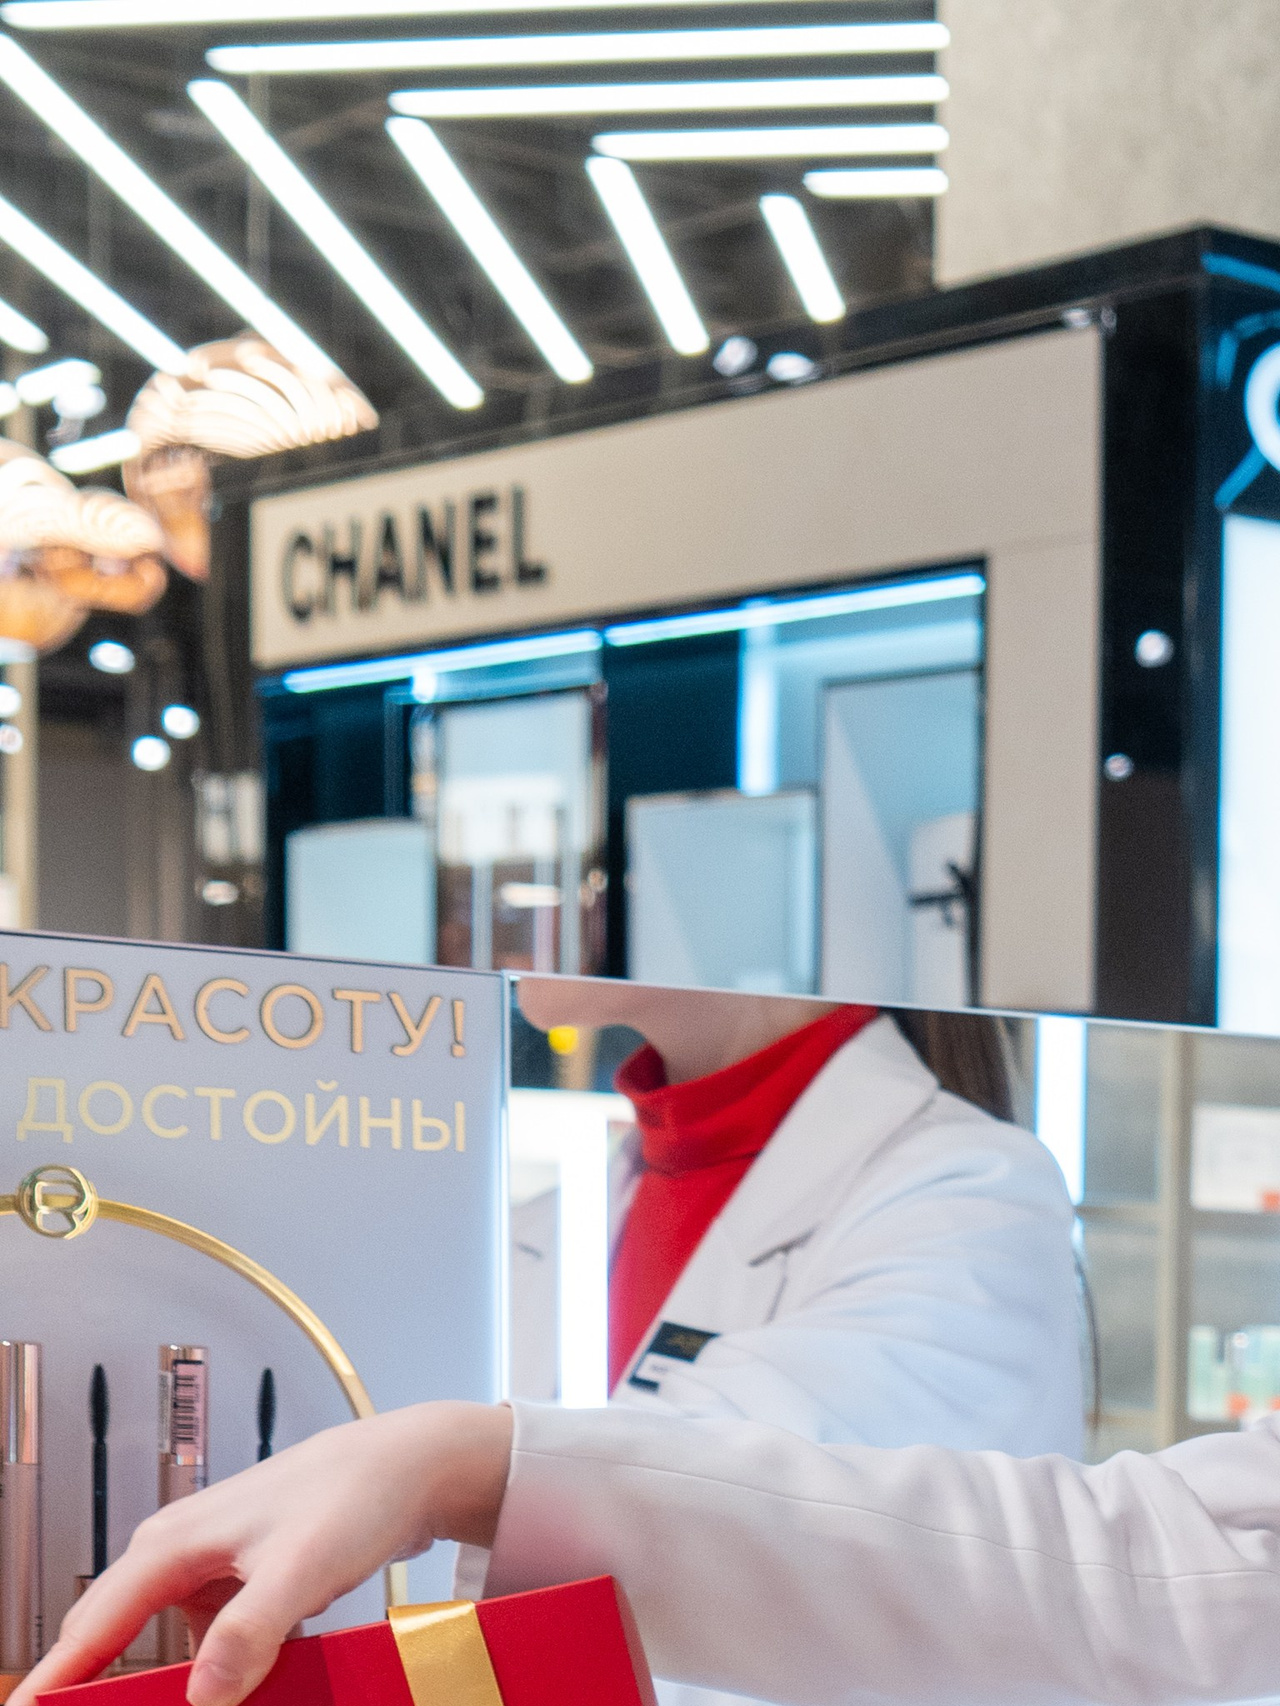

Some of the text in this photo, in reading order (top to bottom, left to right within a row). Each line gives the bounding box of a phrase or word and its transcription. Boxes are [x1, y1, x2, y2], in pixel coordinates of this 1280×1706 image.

[280, 481, 550, 626] CHANEL
[0, 962, 466, 1058] КРАСОТУ!
[15, 1076, 466, 1152] ДОСТОЙНЫ
